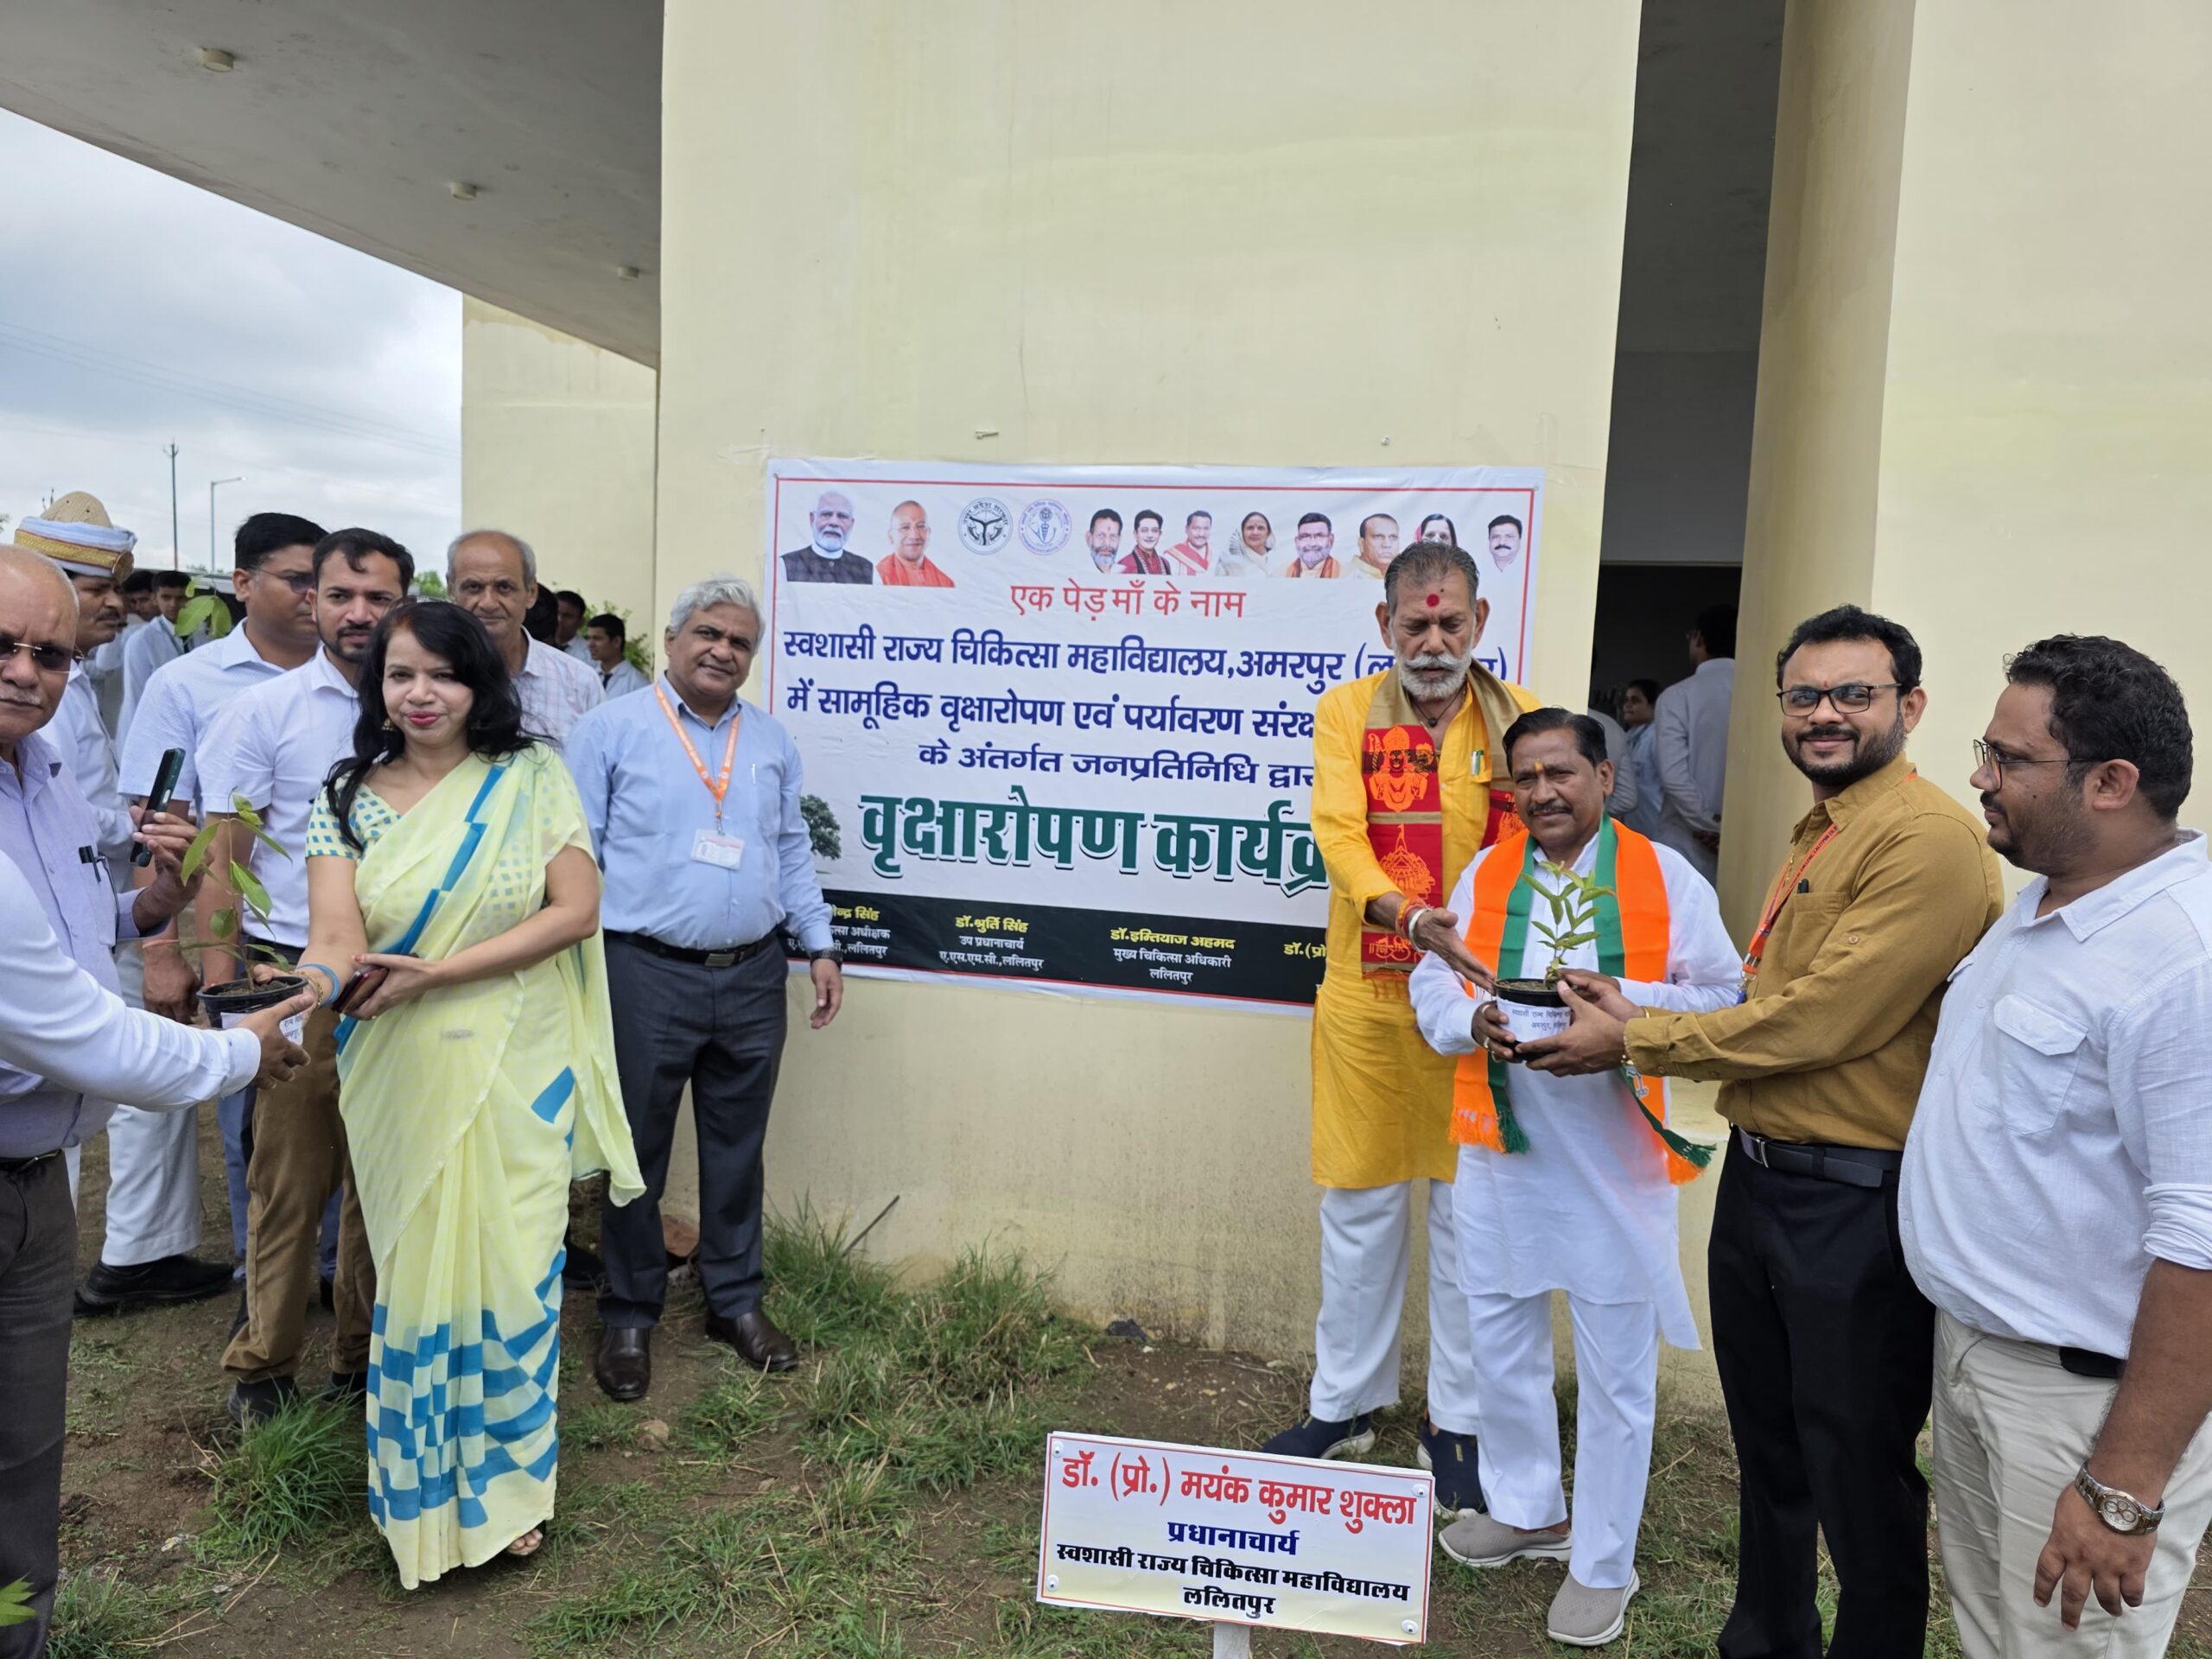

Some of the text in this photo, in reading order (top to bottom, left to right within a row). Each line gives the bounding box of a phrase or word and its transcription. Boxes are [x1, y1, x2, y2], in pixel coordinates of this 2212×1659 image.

[1010, 578, 1247, 622] एक पेड़ माँ के नाम
[784, 623, 876, 660] स्वशासी
[883, 636, 944, 663] राज्य
[951, 627, 1060, 669] चिकित्सा
[786, 677, 1315, 738] में सामूहिक वृक्षारोपण एवं पर्यावरण संरक्ष
[918, 738, 951, 766] के
[958, 741, 1064, 772] अंतर्गत
[1071, 749, 1260, 784] जनप्रतिनिधि
[859, 785, 1329, 896] वृक्षारोपण कार्यक्र
[855, 906, 880, 921] सिंह
[1002, 918, 1030, 933] सिंह
[851, 925, 892, 940] अधीक्षक
[959, 935, 1025, 950] उप प्रधानाचार्य
[1190, 936, 1236, 950] अहमद
[1113, 947, 1232, 969] मुख्य चिकित्सा अधिकारी
[1149, 967, 1194, 985] ललितपुर
[1061, 1449, 1417, 1535] डॉ. (प्रो.) मयंक कुमार शुक्ला
[1167, 1521, 1300, 1555] प्रधानाचार्य
[1056, 1543, 1411, 1602] स्वशासी राज्य चिकित्सा महाविद्यालय
[1183, 1586, 1277, 1618] ललितपुर
